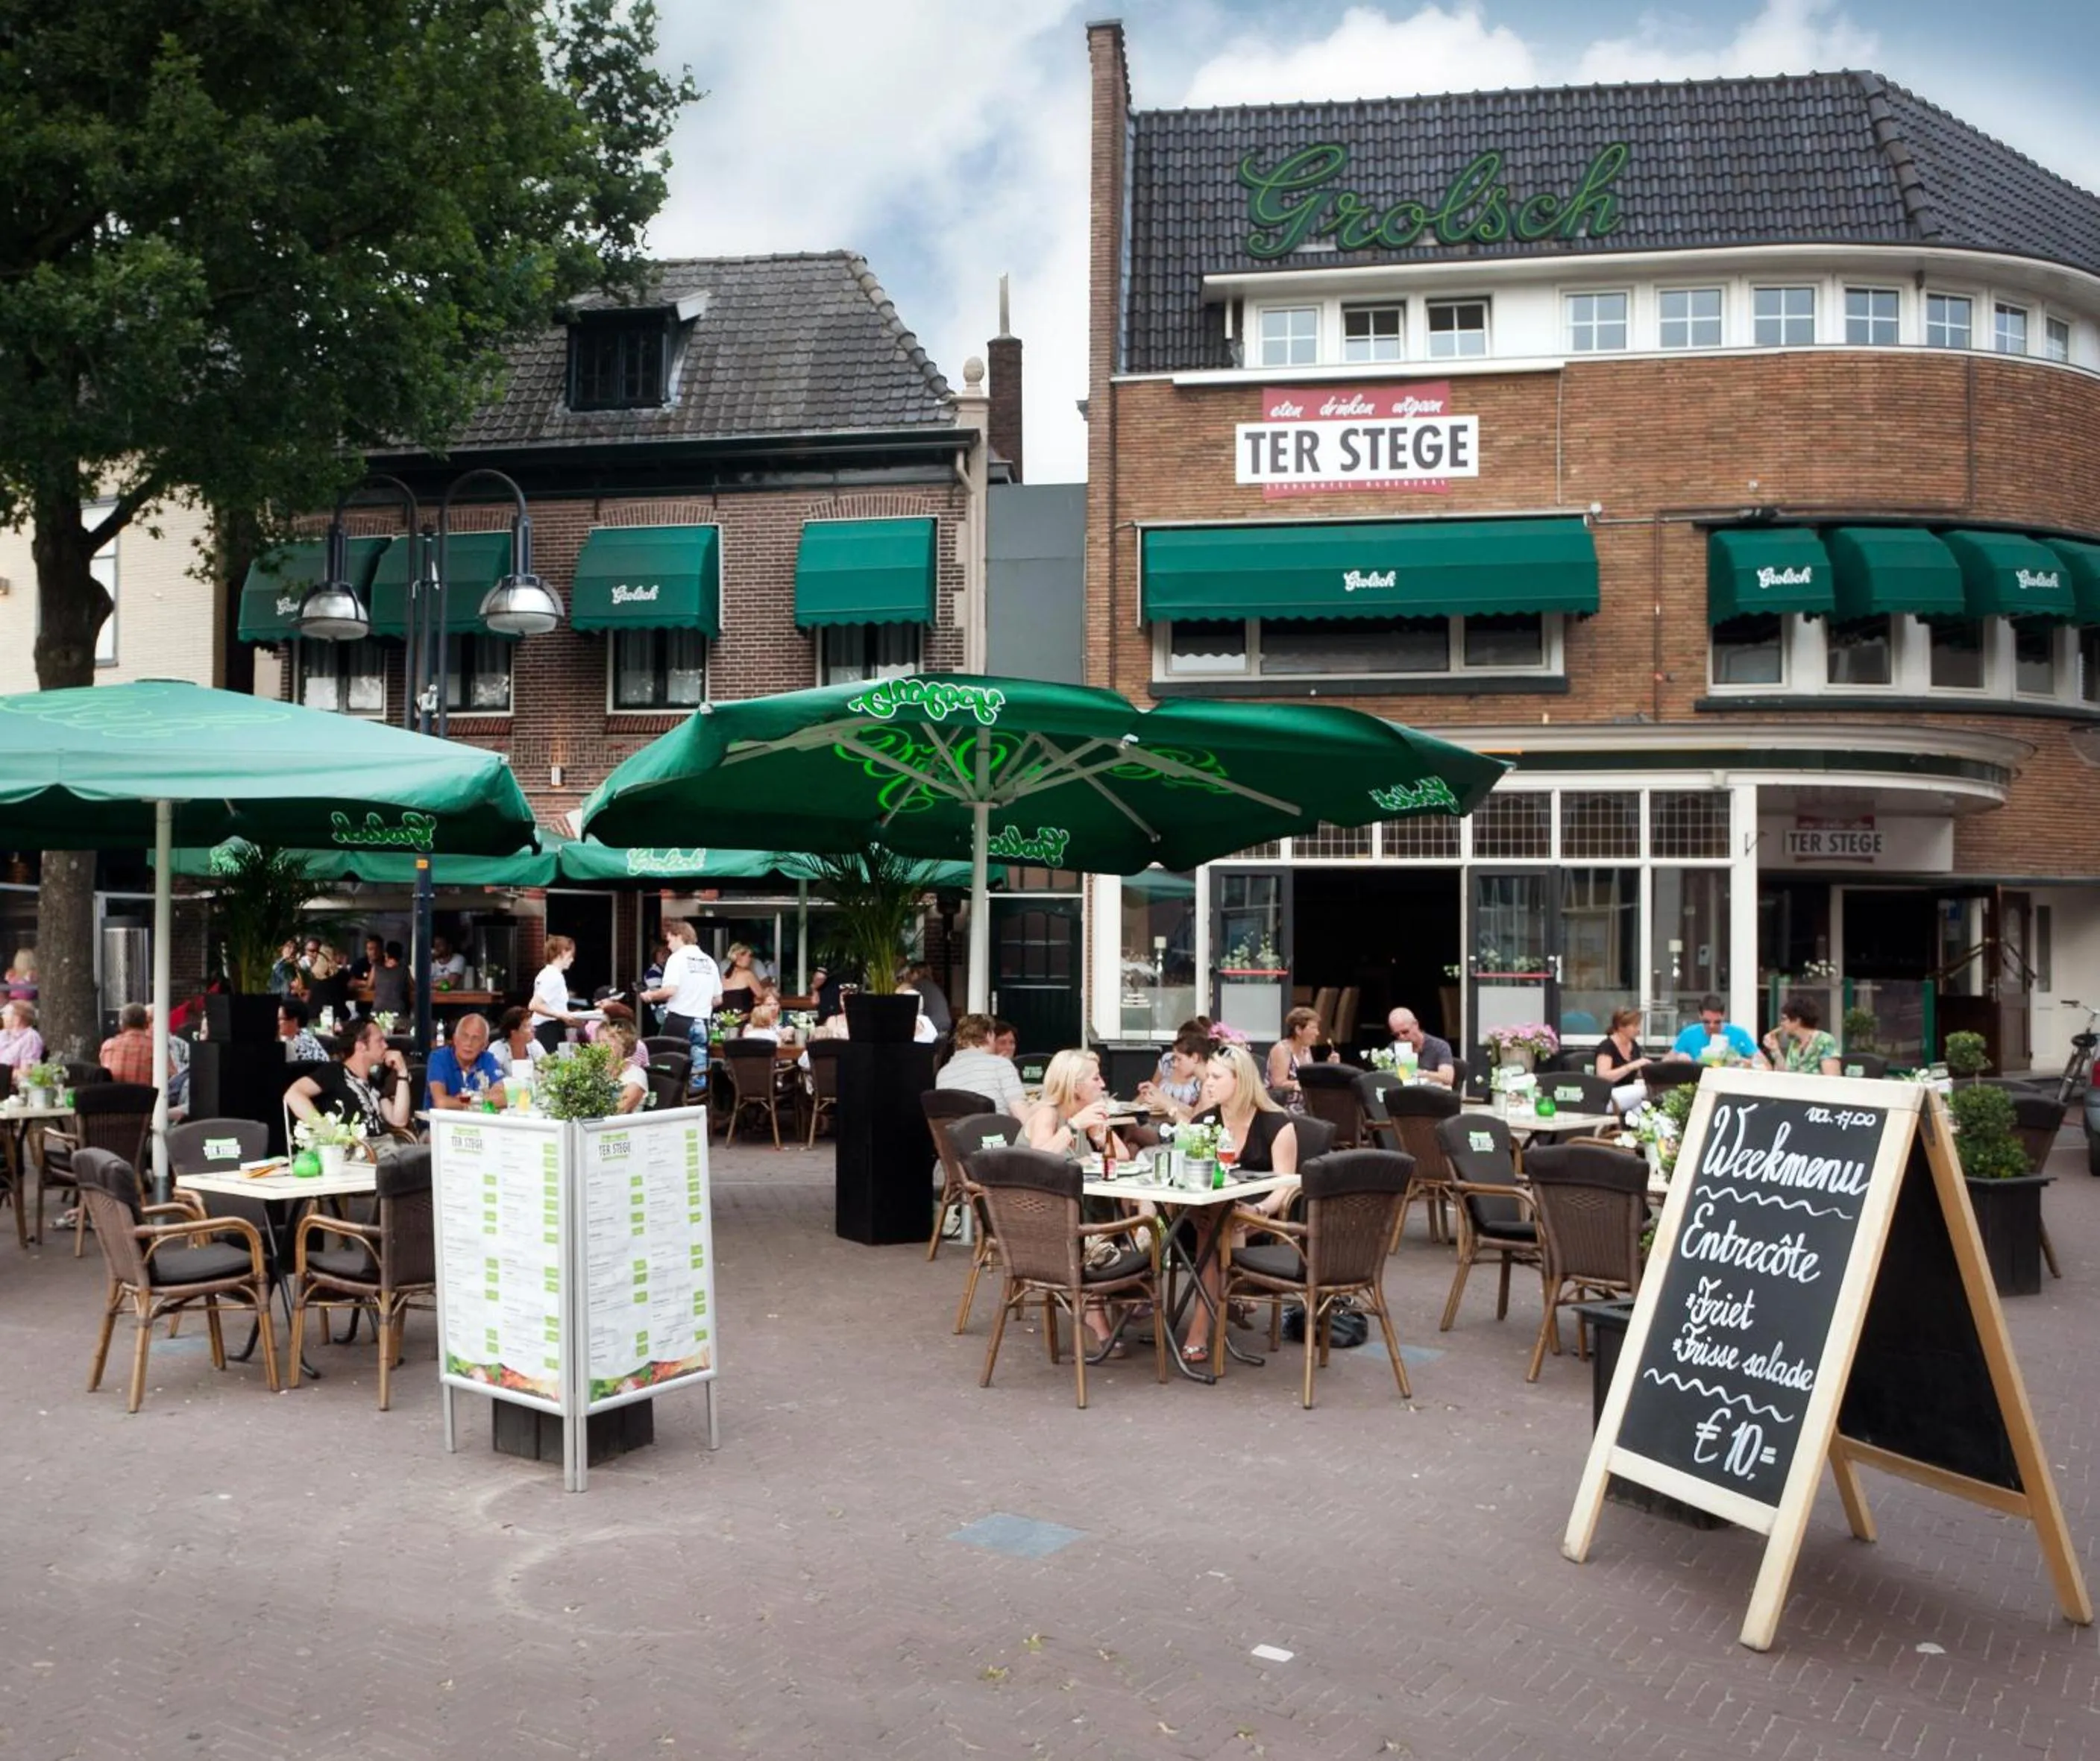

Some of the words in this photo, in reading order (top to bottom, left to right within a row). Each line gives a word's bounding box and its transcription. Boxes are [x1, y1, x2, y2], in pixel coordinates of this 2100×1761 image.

[1238, 142, 1631, 258] Grolsch
[1244, 429, 1321, 474] TER
[1339, 424, 1468, 472] STEGE
[612, 585, 659, 605] Grolsch
[1343, 570, 1396, 591] Grolsch
[1756, 567, 1813, 589] Grolsch
[1789, 832, 1822, 853] TER
[1829, 832, 1882, 853] STEGE
[1703, 1103, 1871, 1195] Weekmenu
[1681, 1203, 1821, 1283] Entrecôte
[1741, 1341, 1814, 1391] salade
